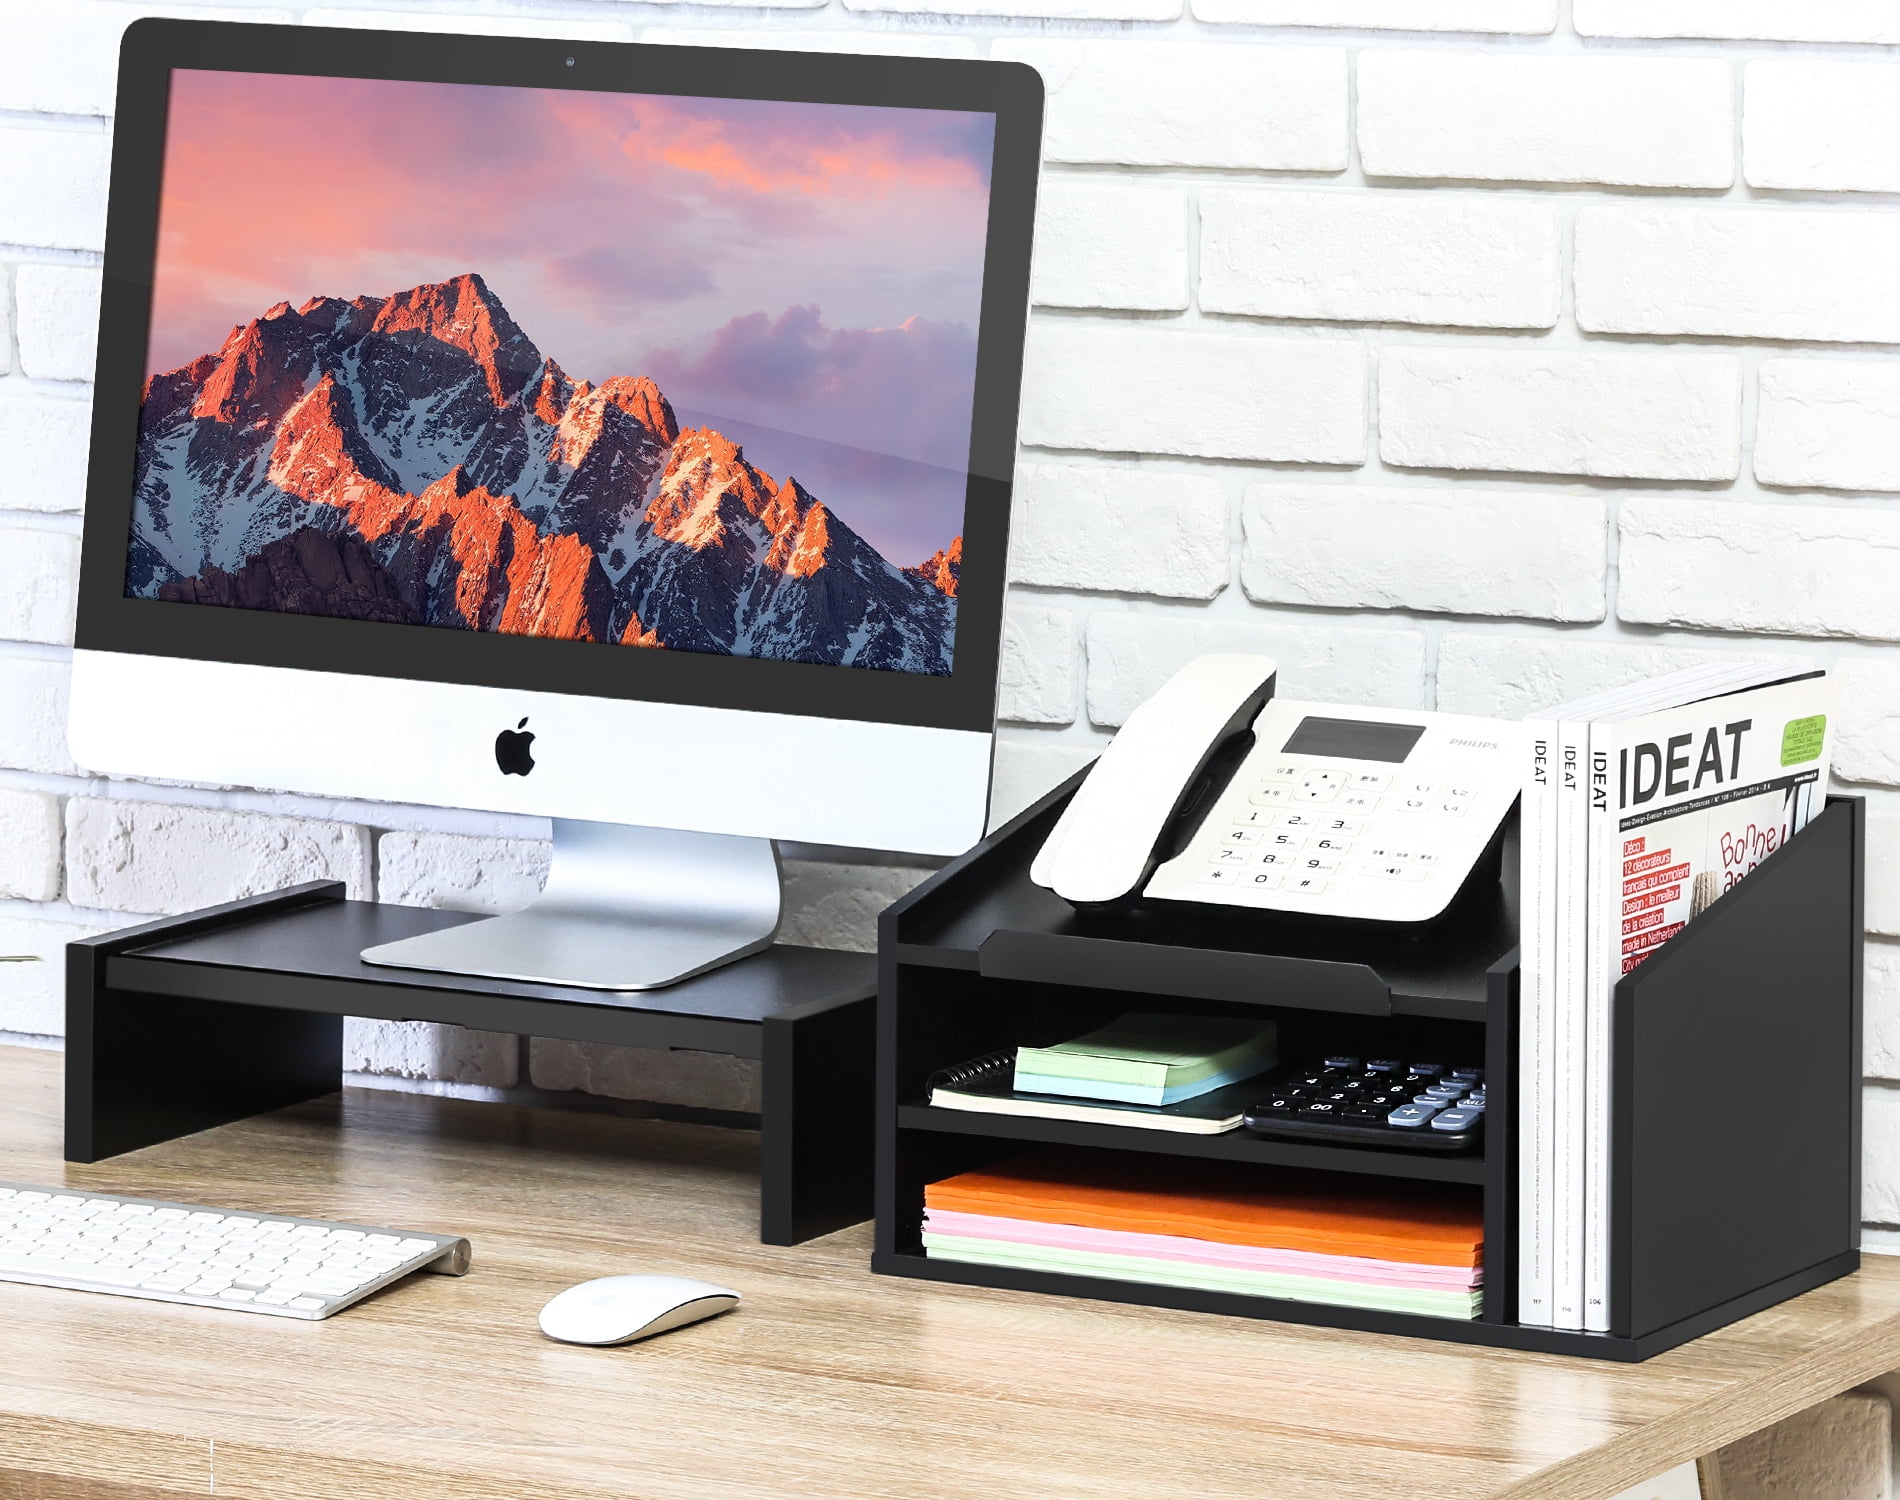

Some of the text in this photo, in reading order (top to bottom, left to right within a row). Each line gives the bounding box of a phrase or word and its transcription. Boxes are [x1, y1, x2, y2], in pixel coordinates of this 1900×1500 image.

[1449, 738, 1499, 749] PHILIPS
[1535, 740, 1546, 785] IDEAT
[1619, 719, 1752, 809] IDEAT
[1564, 746, 1576, 791] IDEAT
[1593, 752, 1607, 812] IDEAT
[1250, 812, 1257, 820] 1
[1288, 815, 1301, 825] 2
[1331, 820, 1345, 829] 3
[1232, 831, 1243, 840] 4
[1275, 835, 1289, 844] 5
[1318, 840, 1331, 848] 6
[1624, 841, 1641, 855] Déco
[1720, 823, 1776, 869] Bonne
[1221, 850, 1233, 858] 7
[1263, 854, 1276, 863] 8
[1307, 859, 1320, 868] 9
[1624, 861, 1632, 875] 12
[1255, 874, 1267, 883] 0
[1648, 872, 1658, 888] qui
[1623, 899, 1645, 915] Design
[1622, 921, 1631, 934] de
[1622, 938, 1640, 953] made
[1641, 935, 1647, 947] in
[1310, 1103, 1332, 1111] 00
